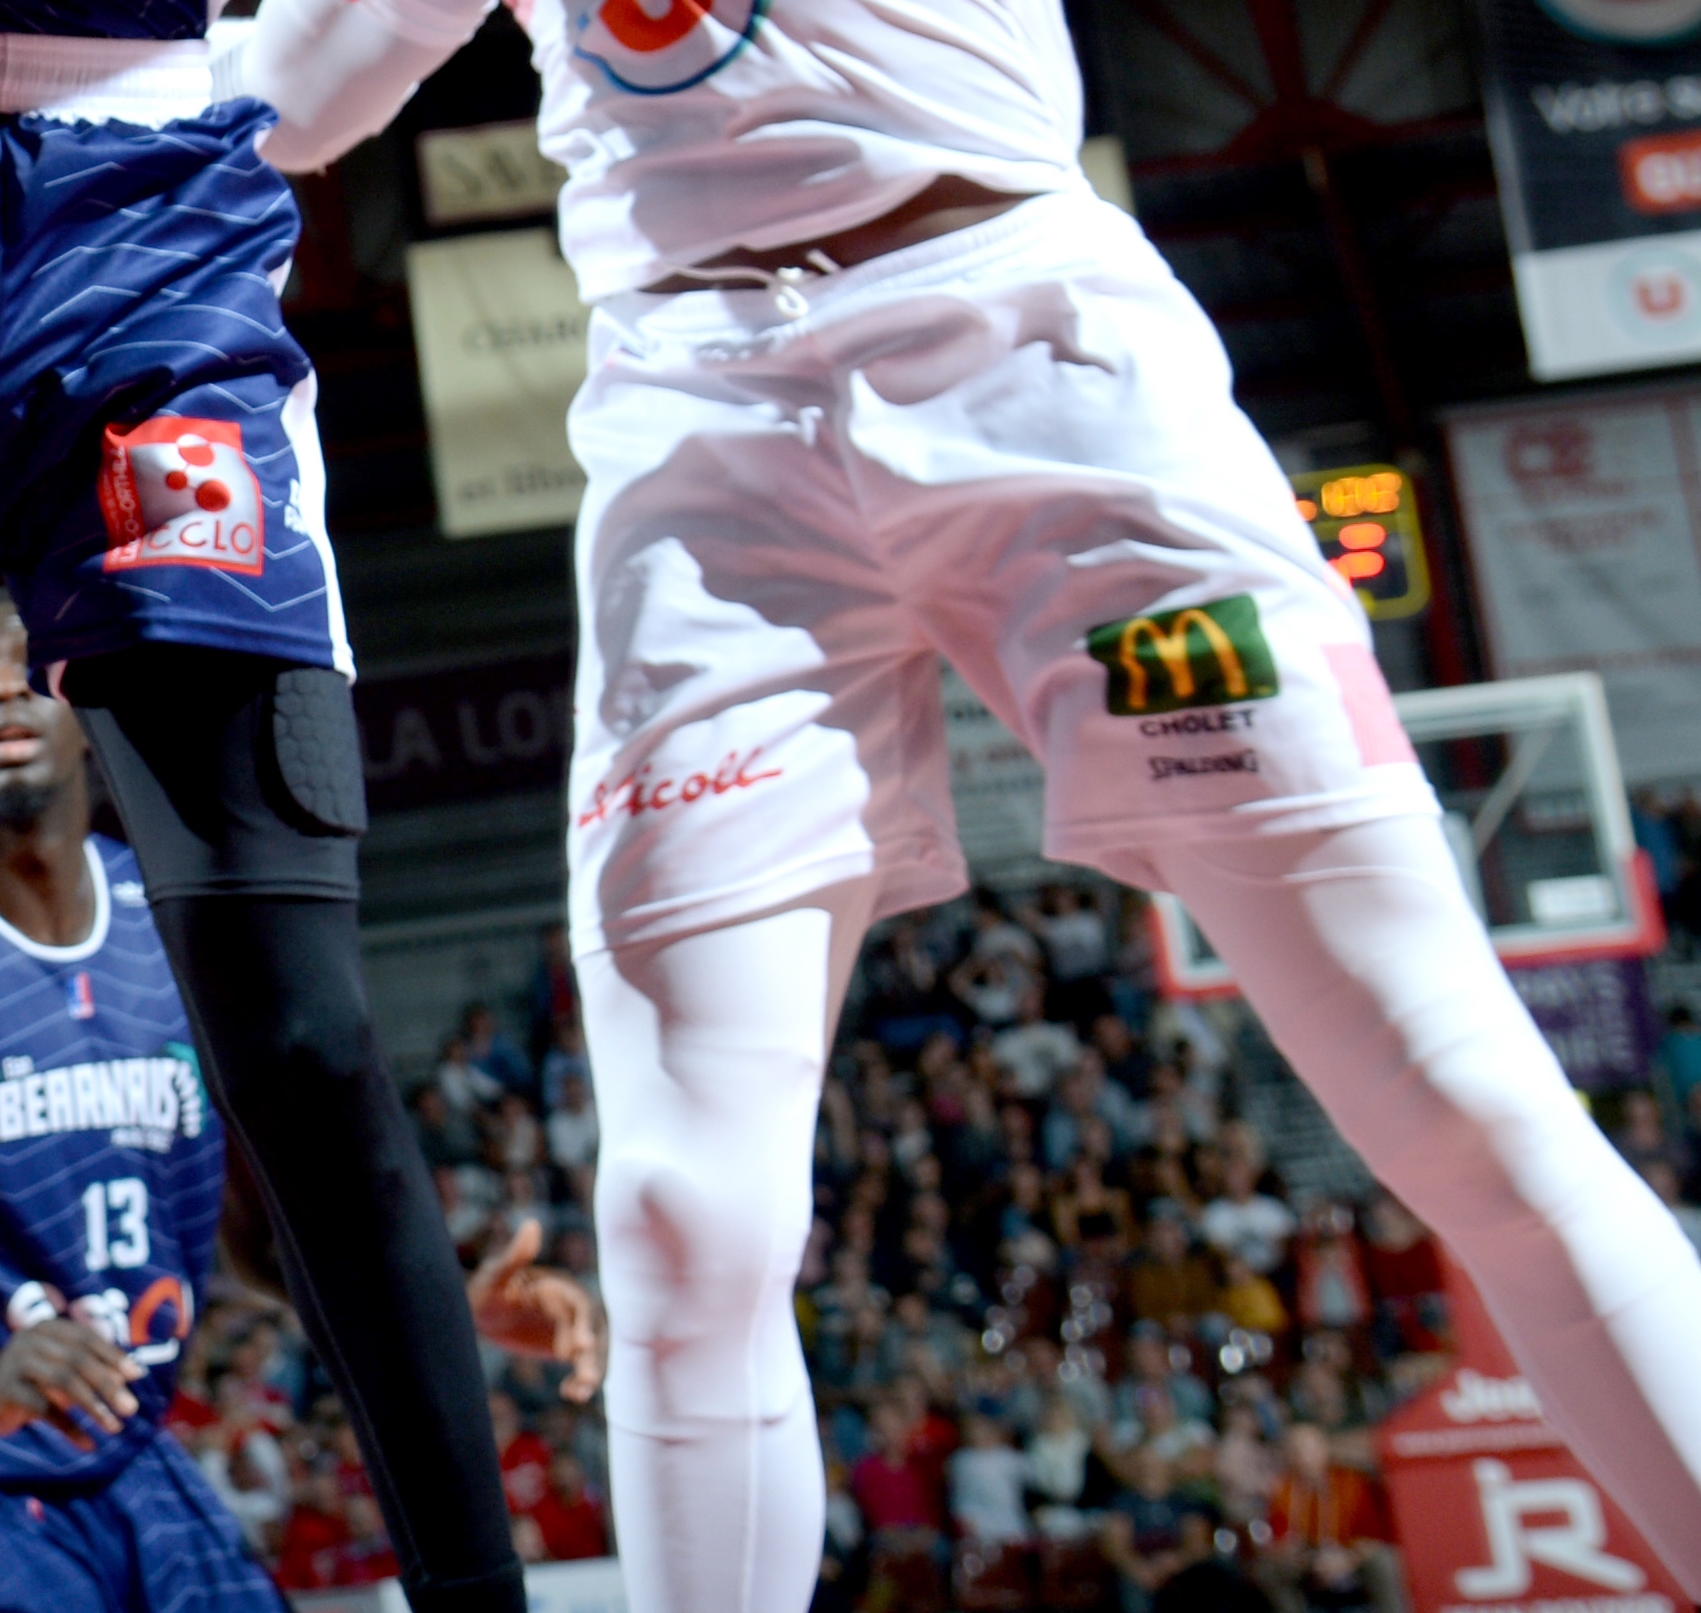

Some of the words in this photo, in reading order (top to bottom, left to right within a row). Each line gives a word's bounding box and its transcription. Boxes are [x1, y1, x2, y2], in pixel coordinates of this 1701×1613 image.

[148, 518, 257, 556] CCLO
[456, 686, 574, 766] LO
[1140, 708, 1257, 737] CHOLET
[1148, 748, 1261, 781] SPALDING
[81, 1176, 151, 1273] 13
